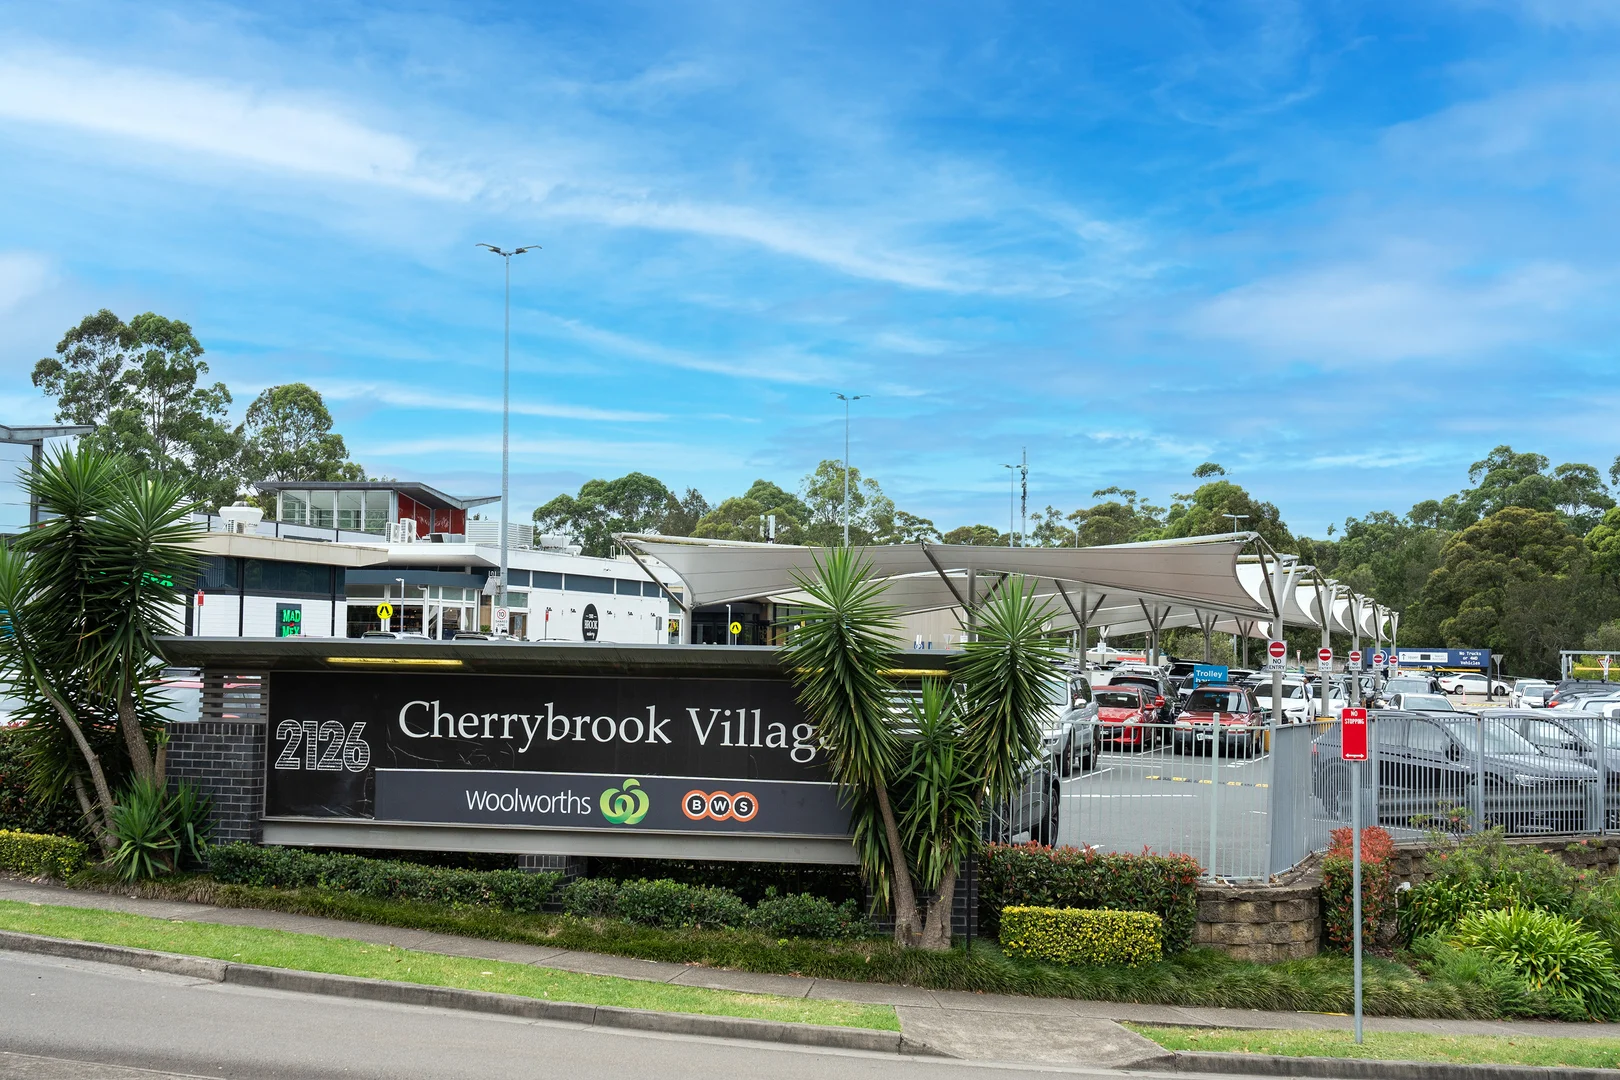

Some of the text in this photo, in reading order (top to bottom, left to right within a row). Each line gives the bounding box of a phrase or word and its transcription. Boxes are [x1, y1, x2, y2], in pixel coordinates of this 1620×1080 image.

[282, 609, 301, 622] MAD
[282, 626, 300, 638] MEX
[1195, 670, 1222, 679] Trolley
[398, 699, 672, 754] Cherrybrook
[274, 719, 371, 773] 2126
[465, 787, 592, 815] Woolworths
